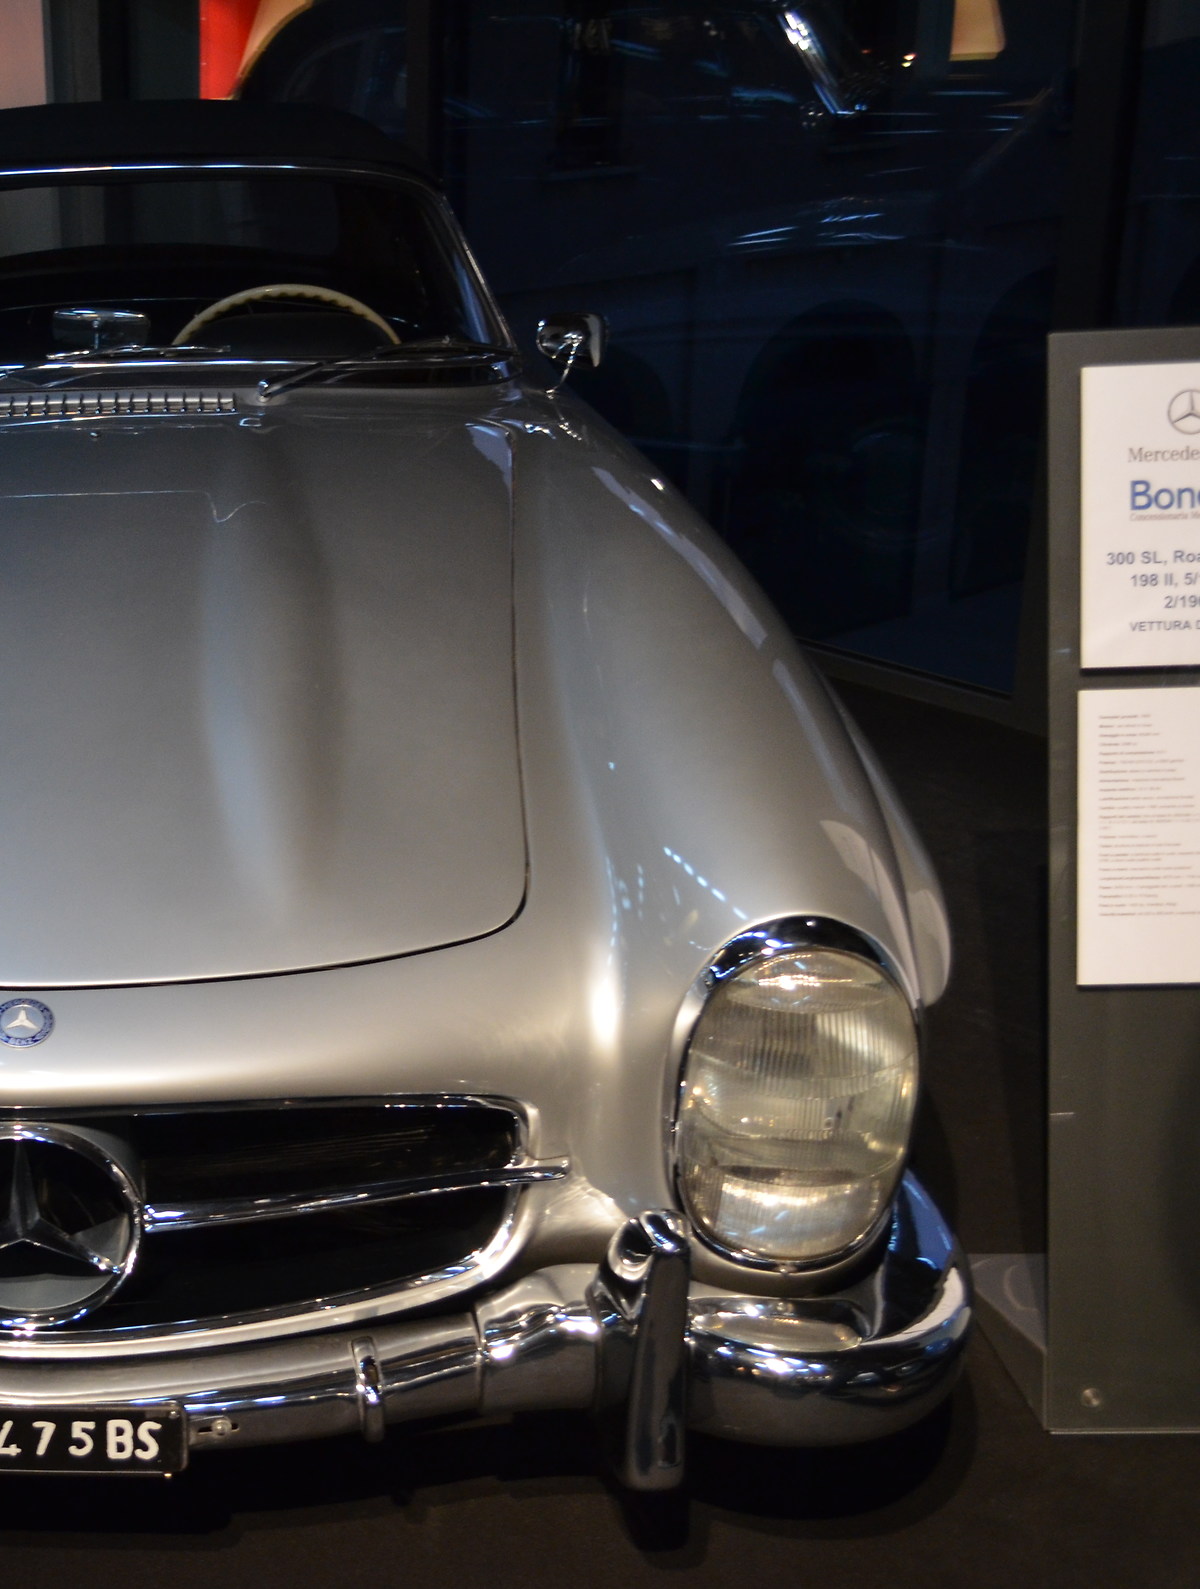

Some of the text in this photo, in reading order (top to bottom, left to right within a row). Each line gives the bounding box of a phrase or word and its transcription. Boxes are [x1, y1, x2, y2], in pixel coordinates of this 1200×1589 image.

[1130, 480, 1200, 511] Bon
[1106, 552, 1135, 566] 300
[1141, 550, 1168, 566] SL,
[1130, 573, 1159, 587] 198
[1163, 594, 1200, 609] 2/19
[1129, 619, 1192, 632] VETTURA
